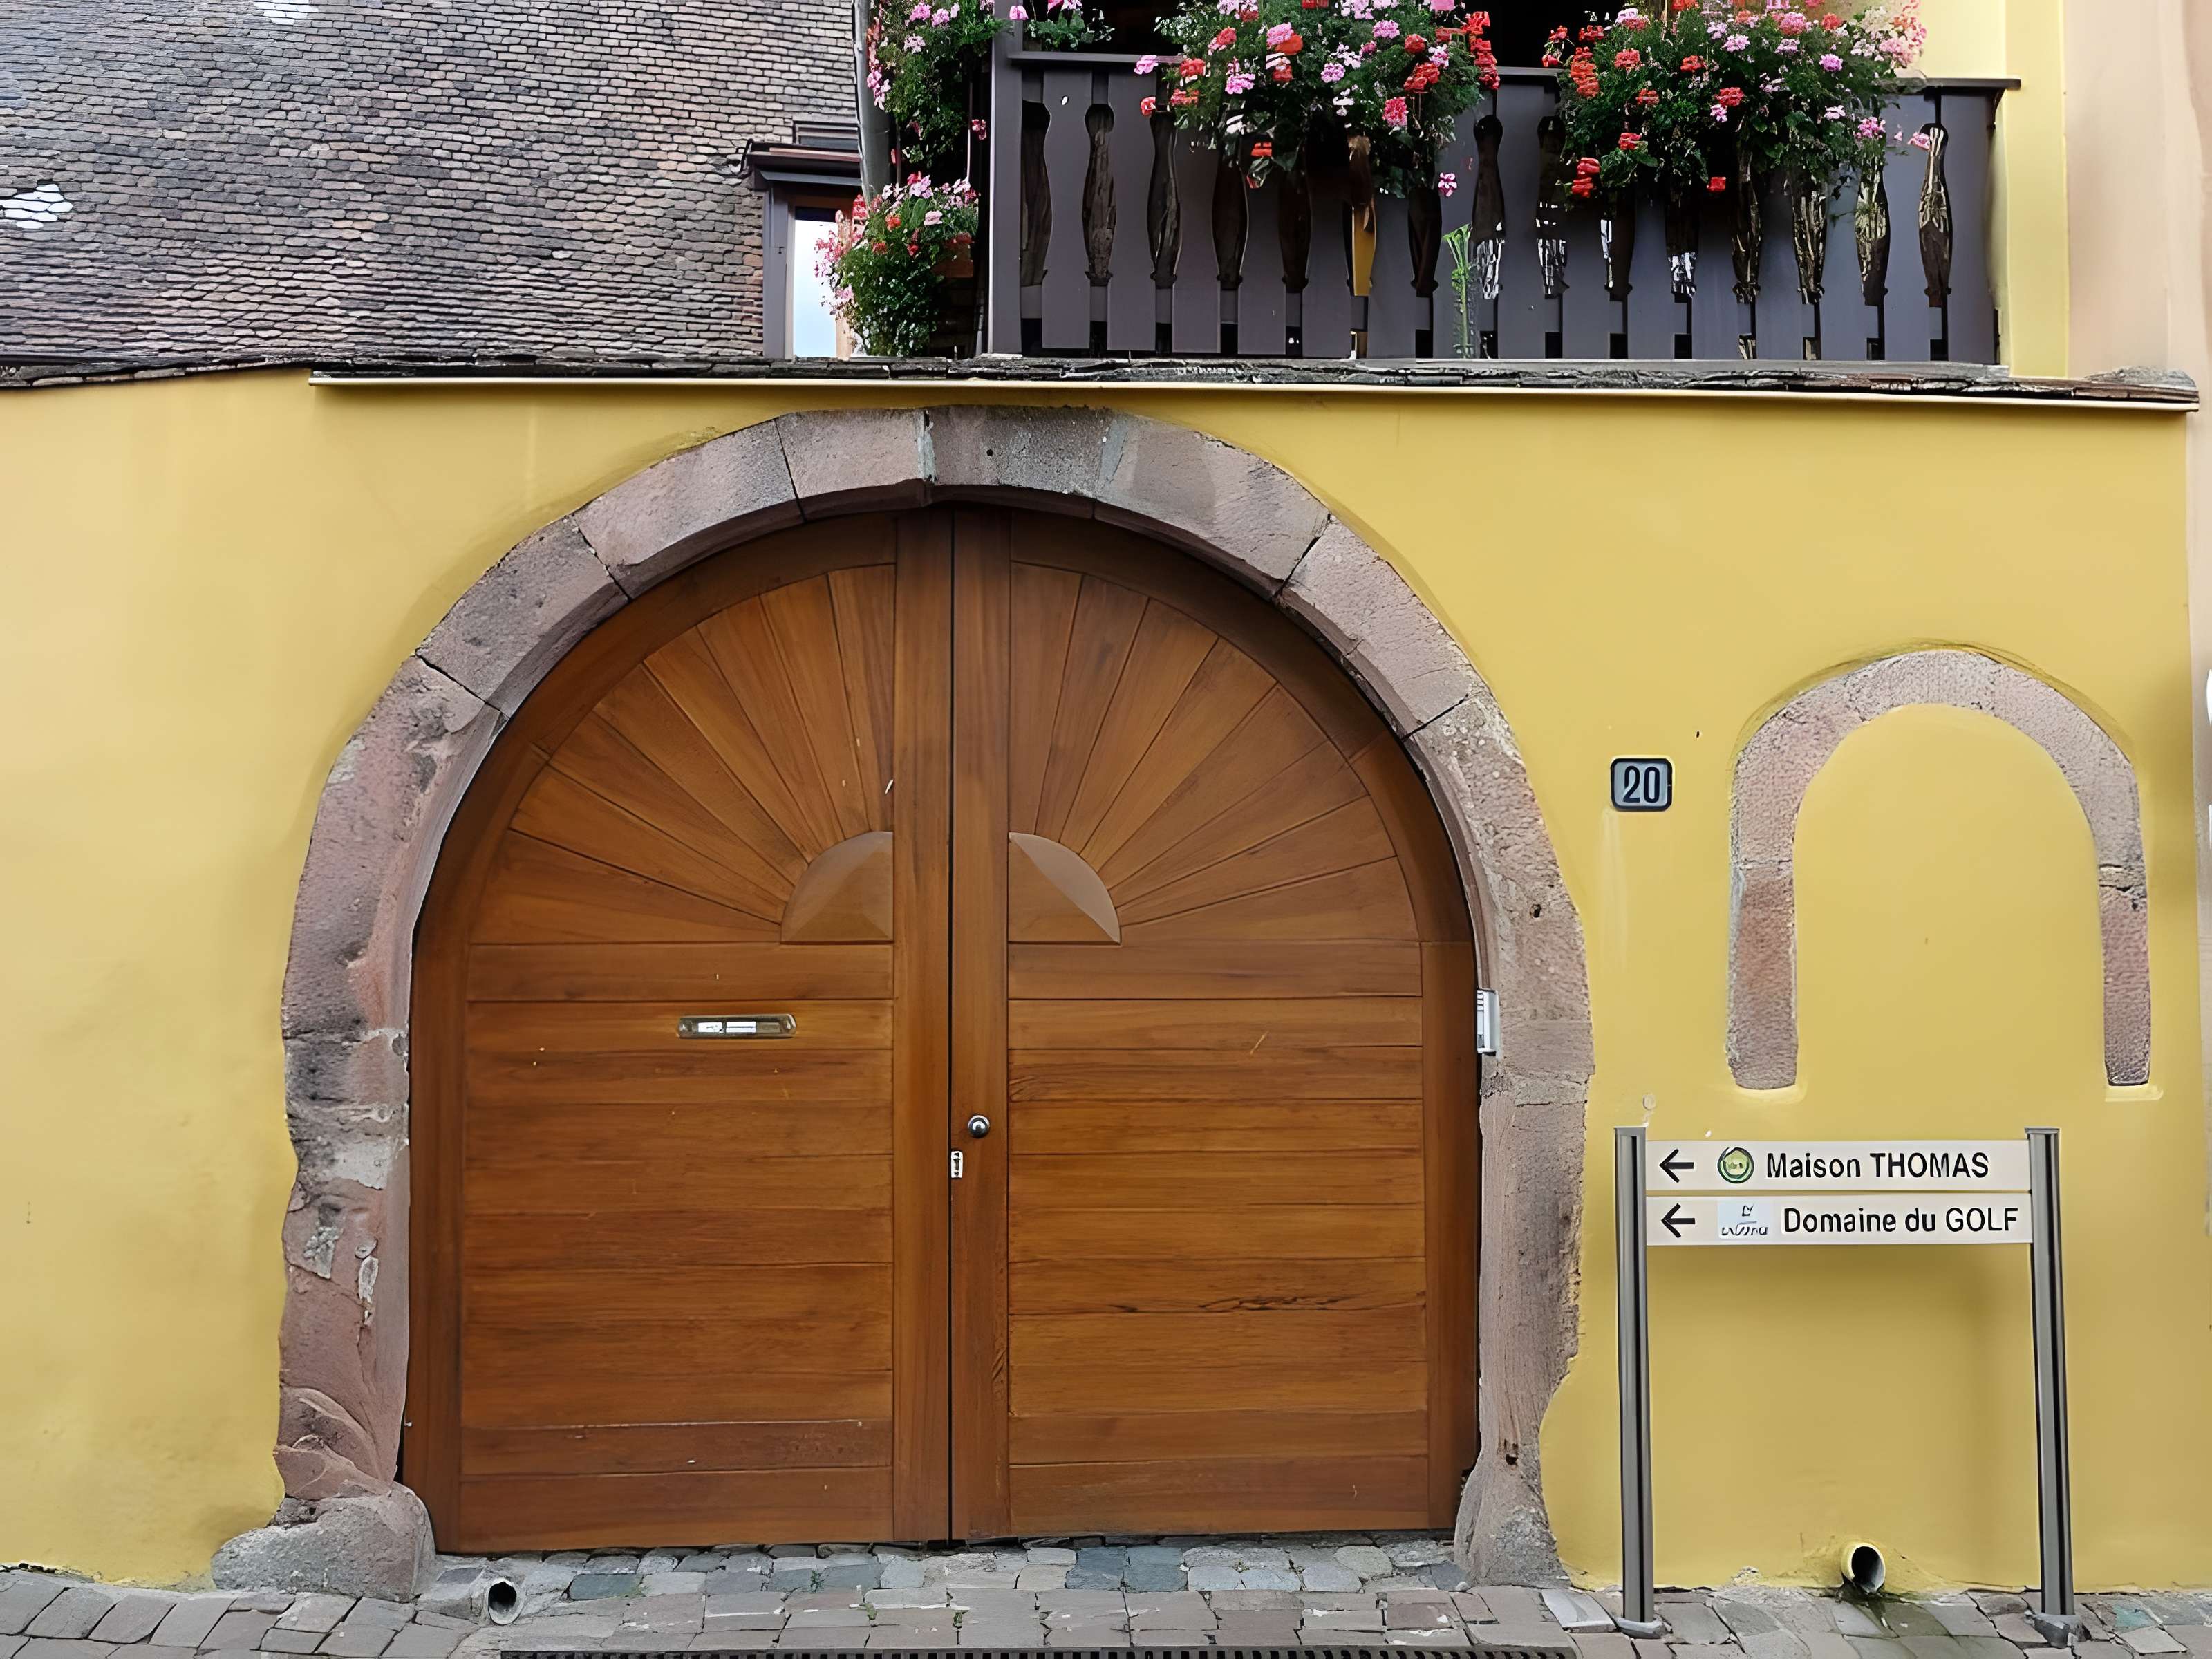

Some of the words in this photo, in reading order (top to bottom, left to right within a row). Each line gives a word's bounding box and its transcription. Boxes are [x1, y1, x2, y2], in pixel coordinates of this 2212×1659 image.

[1622, 765, 1660, 803] 20
[1766, 1152, 1862, 1179] Maison
[1869, 1152, 1989, 1179] THOMAS
[1783, 1207, 1897, 1234] Domaine
[1904, 1207, 1936, 1233] du
[1944, 1206, 2019, 1233] GOLF
